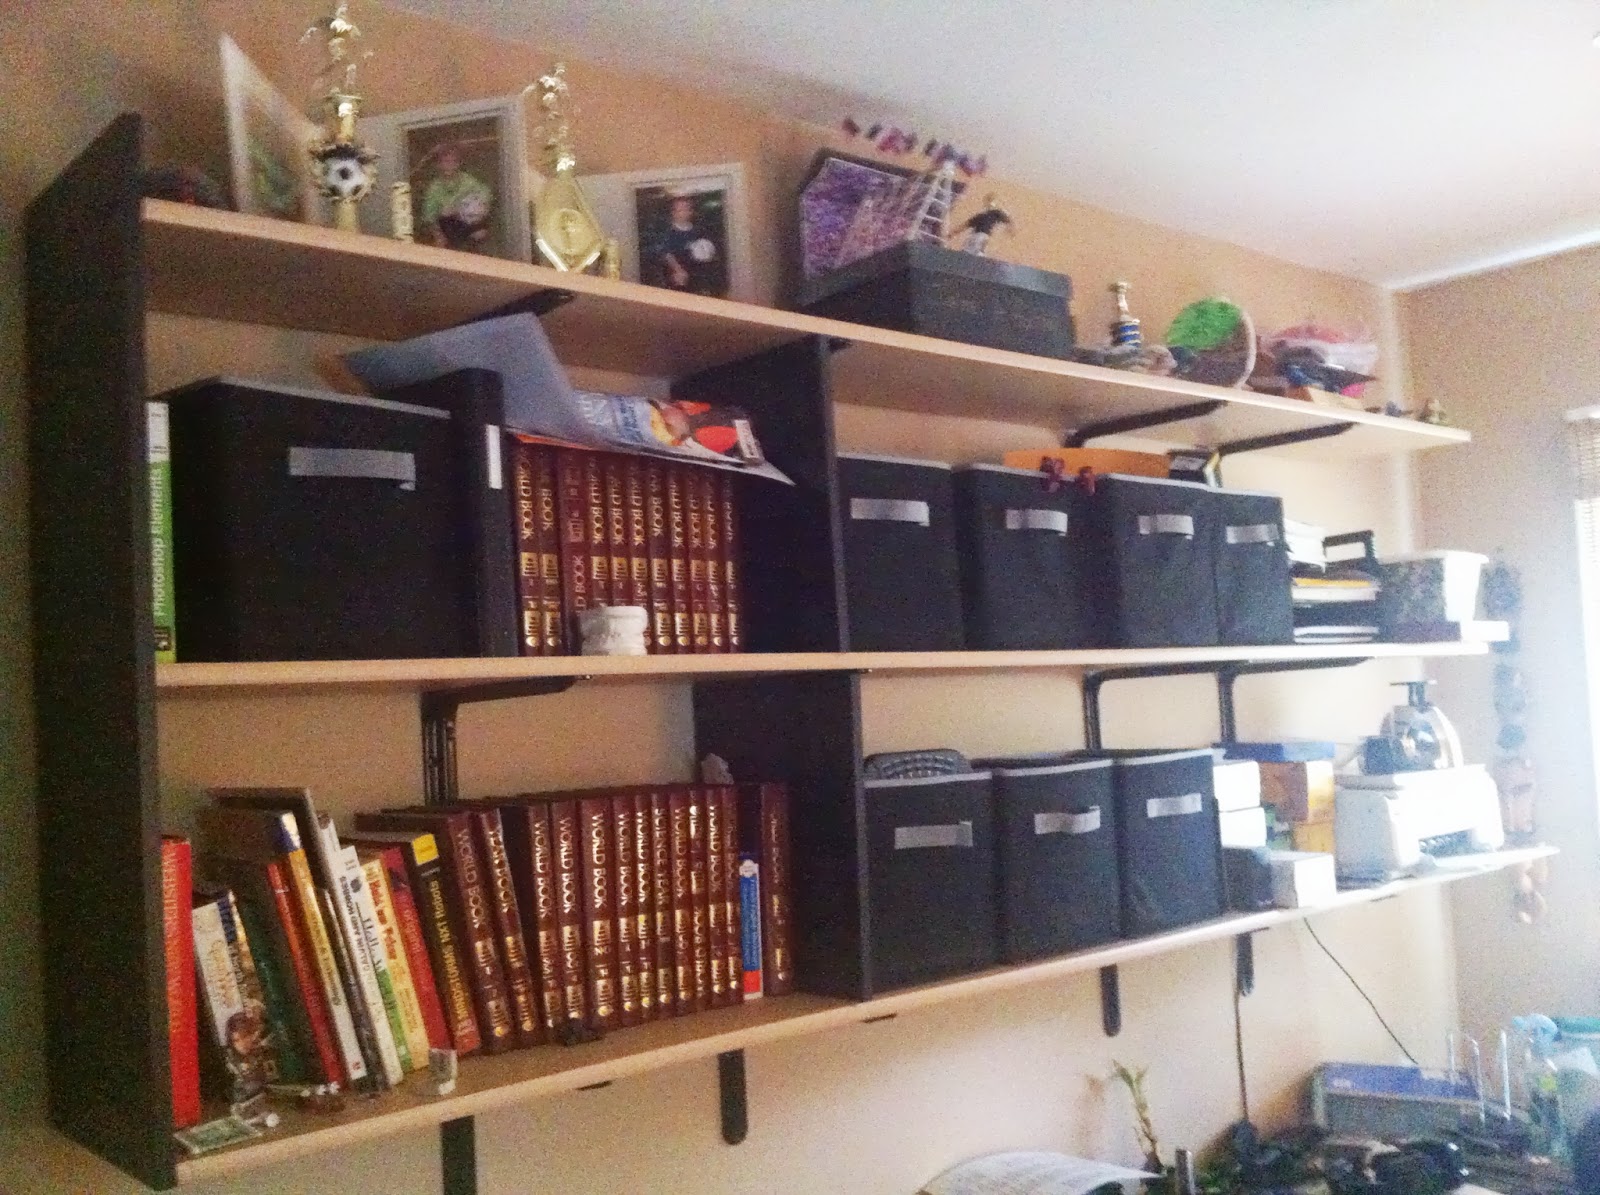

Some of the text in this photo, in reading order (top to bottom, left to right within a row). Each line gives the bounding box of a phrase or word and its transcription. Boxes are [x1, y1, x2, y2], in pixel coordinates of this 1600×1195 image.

[149, 468, 164, 535] Elements
[520, 500, 535, 540] BOOK
[539, 488, 555, 532] BOOK
[590, 506, 605, 545] BOOK
[611, 507, 624, 546] BOOK
[630, 466, 645, 546] RLD BOOK
[651, 496, 664, 538] BOOK
[671, 511, 684, 548] BOOK
[690, 512, 702, 549] BOOK
[151, 537, 167, 616] Photoshop
[572, 555, 586, 593] BOOK
[487, 826, 515, 914] YEAR BOOK
[534, 820, 552, 919] WORLD BOOK
[559, 816, 577, 914] WORLD BOOK
[591, 813, 606, 865] WORLD
[617, 813, 633, 906] WORLD BOOK
[636, 810, 651, 903] WORLD BOOK
[654, 807, 670, 906] SCIENCE YEAR
[674, 806, 688, 898] WORLD BOOK
[708, 804, 723, 893] WORLD BOOK
[429, 880, 446, 918] Robots
[456, 828, 486, 930] WORLD BOOK
[592, 867, 608, 909] BOOK
[339, 875, 371, 971] CALVIN AND HOBBES
[436, 919, 452, 943] NXT
[693, 905, 707, 998] WORLD BOOK
